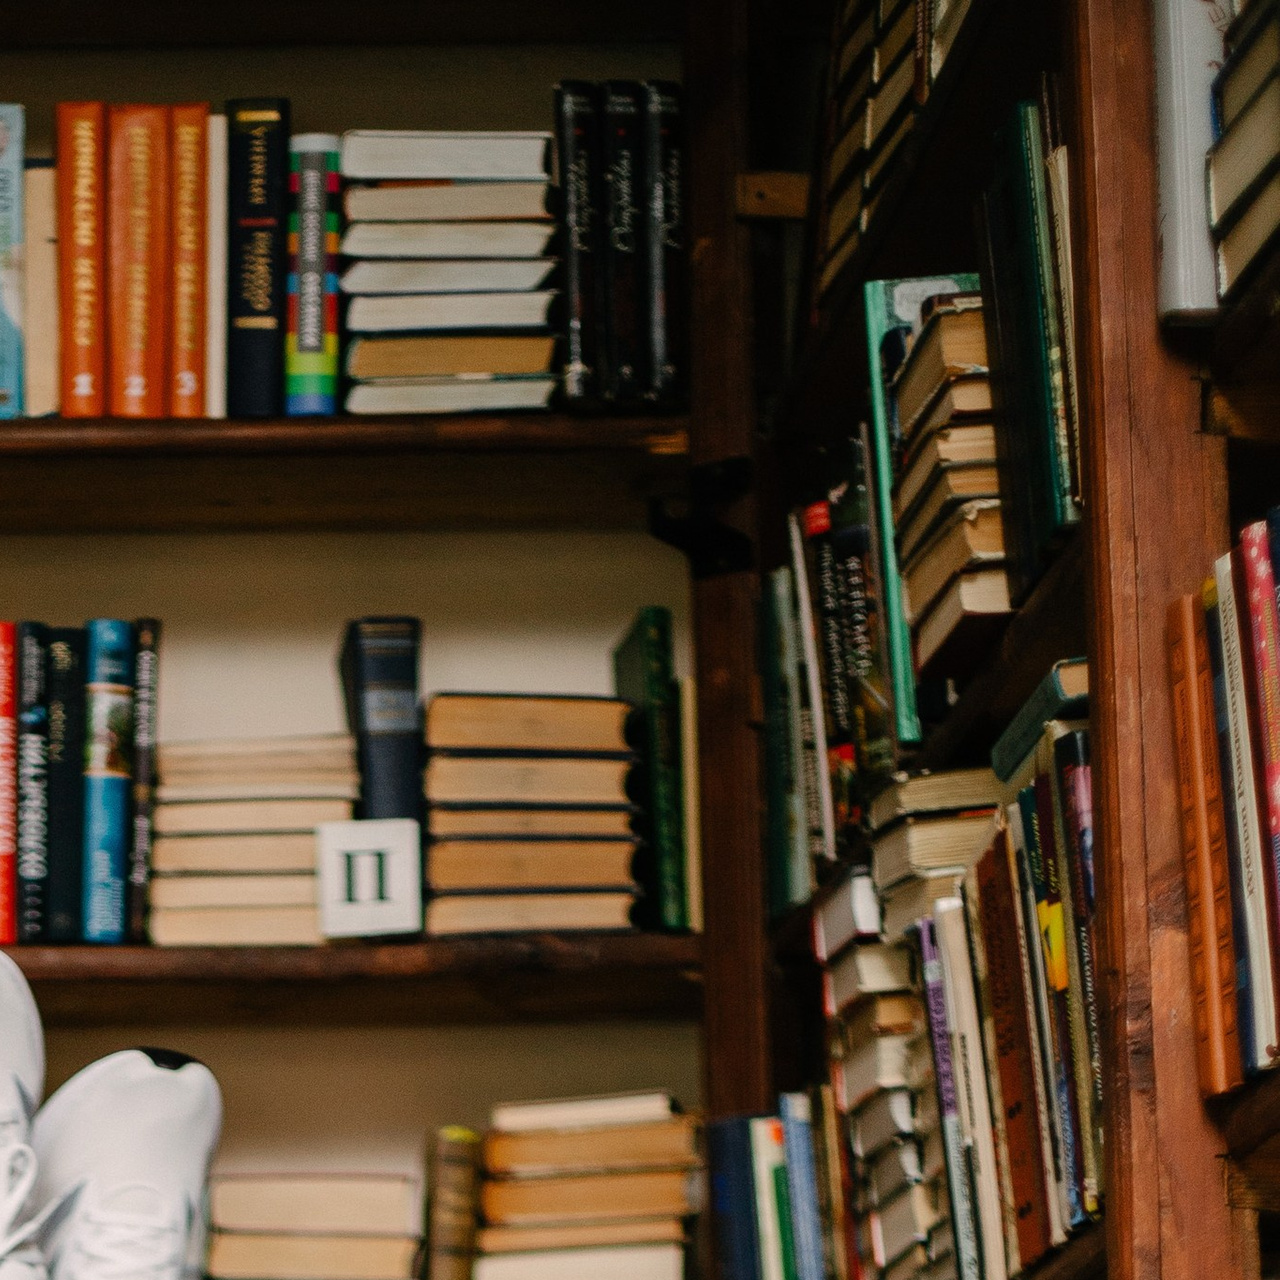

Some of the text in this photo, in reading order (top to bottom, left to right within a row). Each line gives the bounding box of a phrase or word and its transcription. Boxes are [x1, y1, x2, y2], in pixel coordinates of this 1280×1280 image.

[72, 372, 94, 396] 1
[124, 374, 147, 397] 2
[175, 371, 197, 397] 3
[18, 733, 48, 879] ОХЛОБЫСТИН
[339, 849, 389, 904] П
